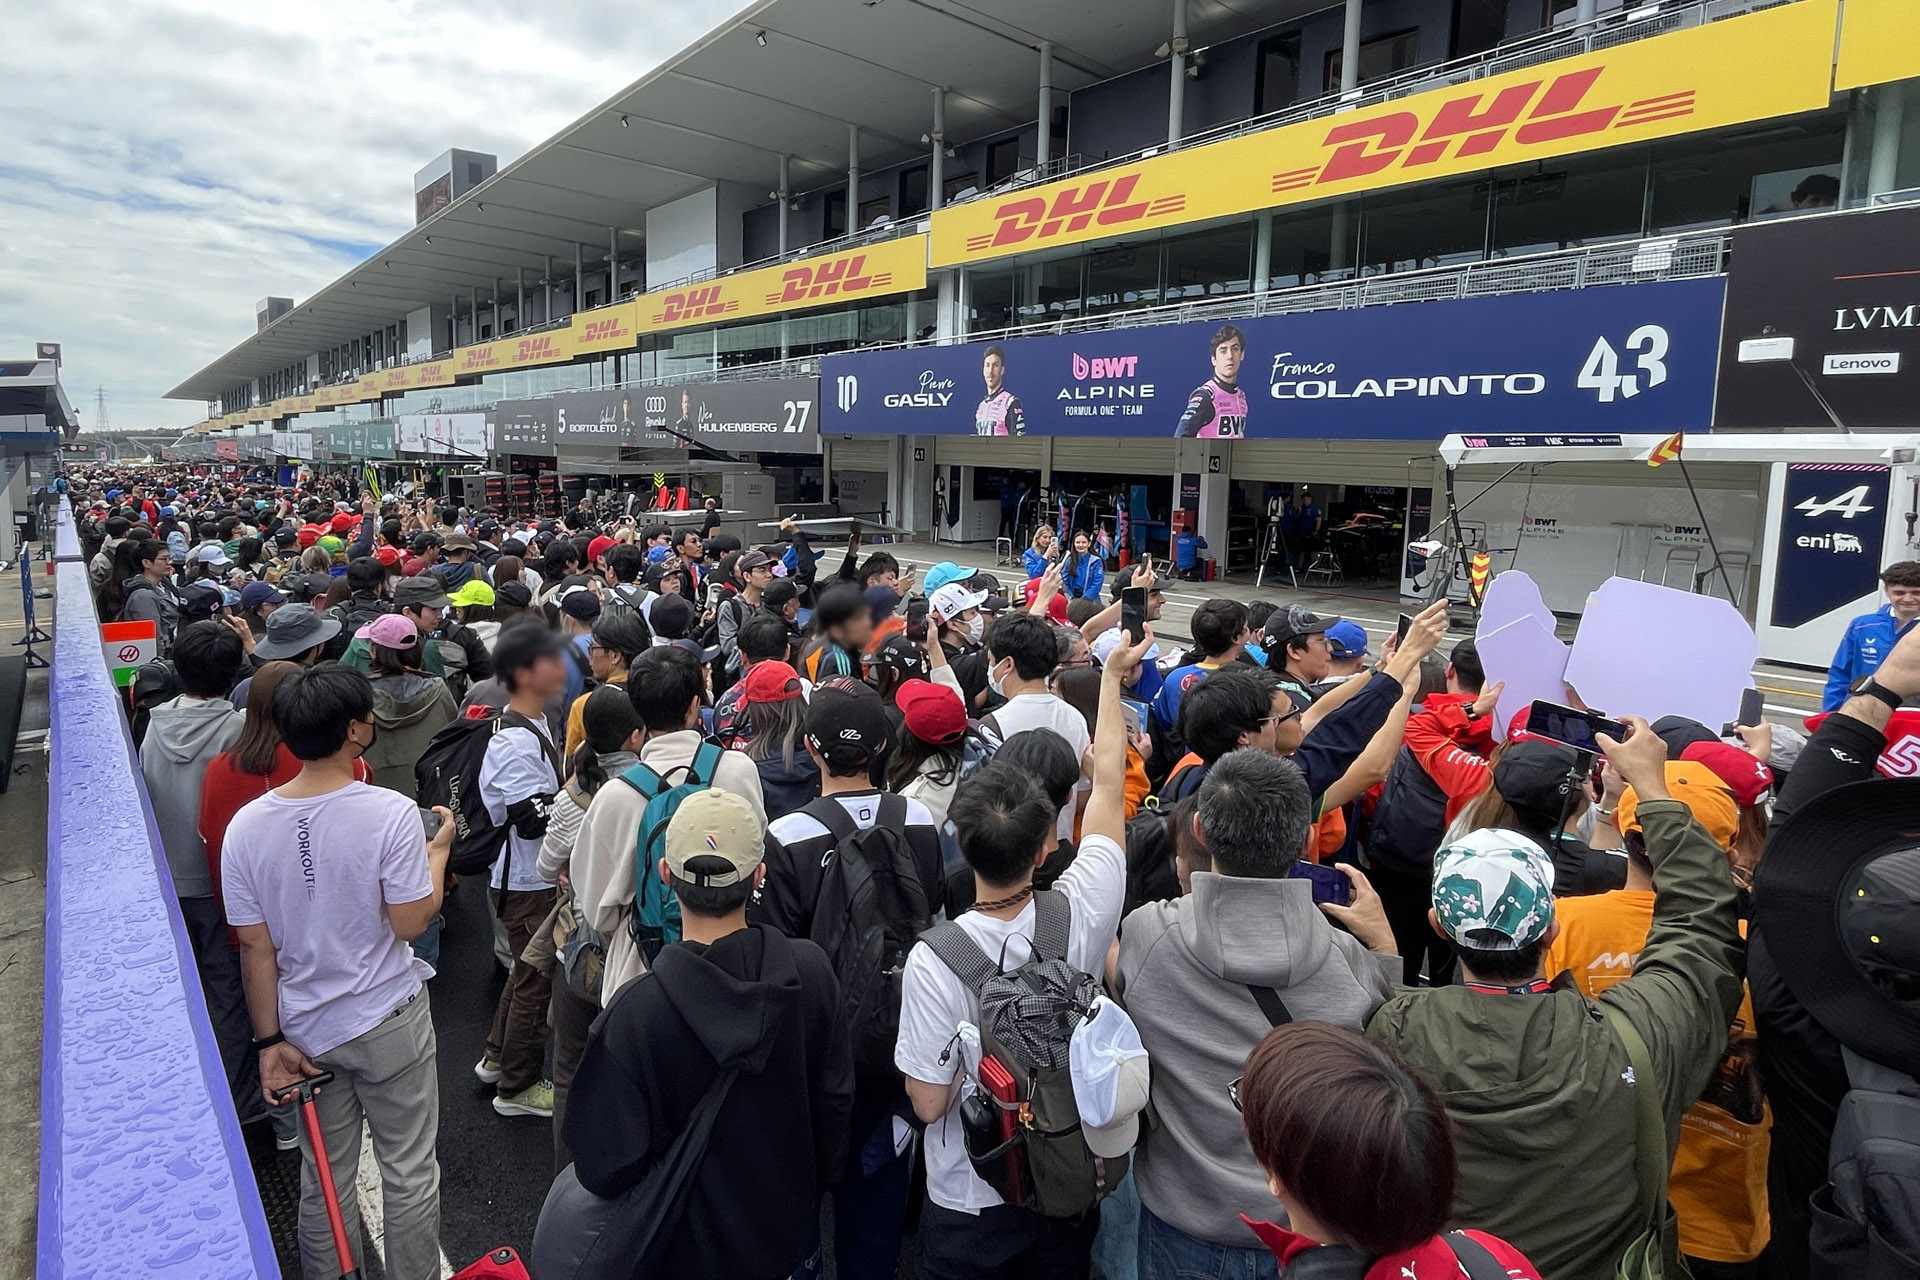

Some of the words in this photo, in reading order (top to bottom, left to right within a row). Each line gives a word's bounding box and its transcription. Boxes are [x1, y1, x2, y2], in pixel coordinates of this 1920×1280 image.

[1316, 65, 1621, 184] DHL
[992, 173, 1151, 247] DHL
[781, 254, 873, 303] DHL
[664, 285, 727, 321] DHL
[1833, 304, 1920, 331] LVM
[585, 318, 622, 342] DHL
[466, 346, 498, 369] DHL
[517, 336, 555, 362] DHL
[420, 364, 444, 383] DHL
[1090, 355, 1139, 379] BWT
[1271, 352, 1336, 378] Franco
[1577, 324, 1669, 403] 43
[1830, 359, 1891, 370] Lenovo
[387, 370, 407, 386] DHL
[918, 369, 955, 393] Pierre
[1270, 373, 1546, 401] COLAPINTO
[836, 374, 858, 414] 10
[883, 391, 954, 409] GASLY
[1056, 384, 1156, 401] ALPINE
[782, 400, 812, 433] 27
[1065, 405, 1098, 416] FORMULA
[1122, 404, 1143, 415] TEAM
[558, 408, 567, 434] 5
[569, 423, 618, 433] BORTOLETO
[698, 422, 778, 433] HULKENBERG
[914, 449, 925, 461] 41
[1209, 457, 1220, 471] 43
[470, 490, 480, 499] 27
[1516, 527, 1565, 535] ALPINE
[1534, 517, 1558, 526] BWT
[1674, 525, 1702, 535] BWT
[1653, 534, 1711, 544] ALPINE
[1796, 532, 1830, 549] eni
